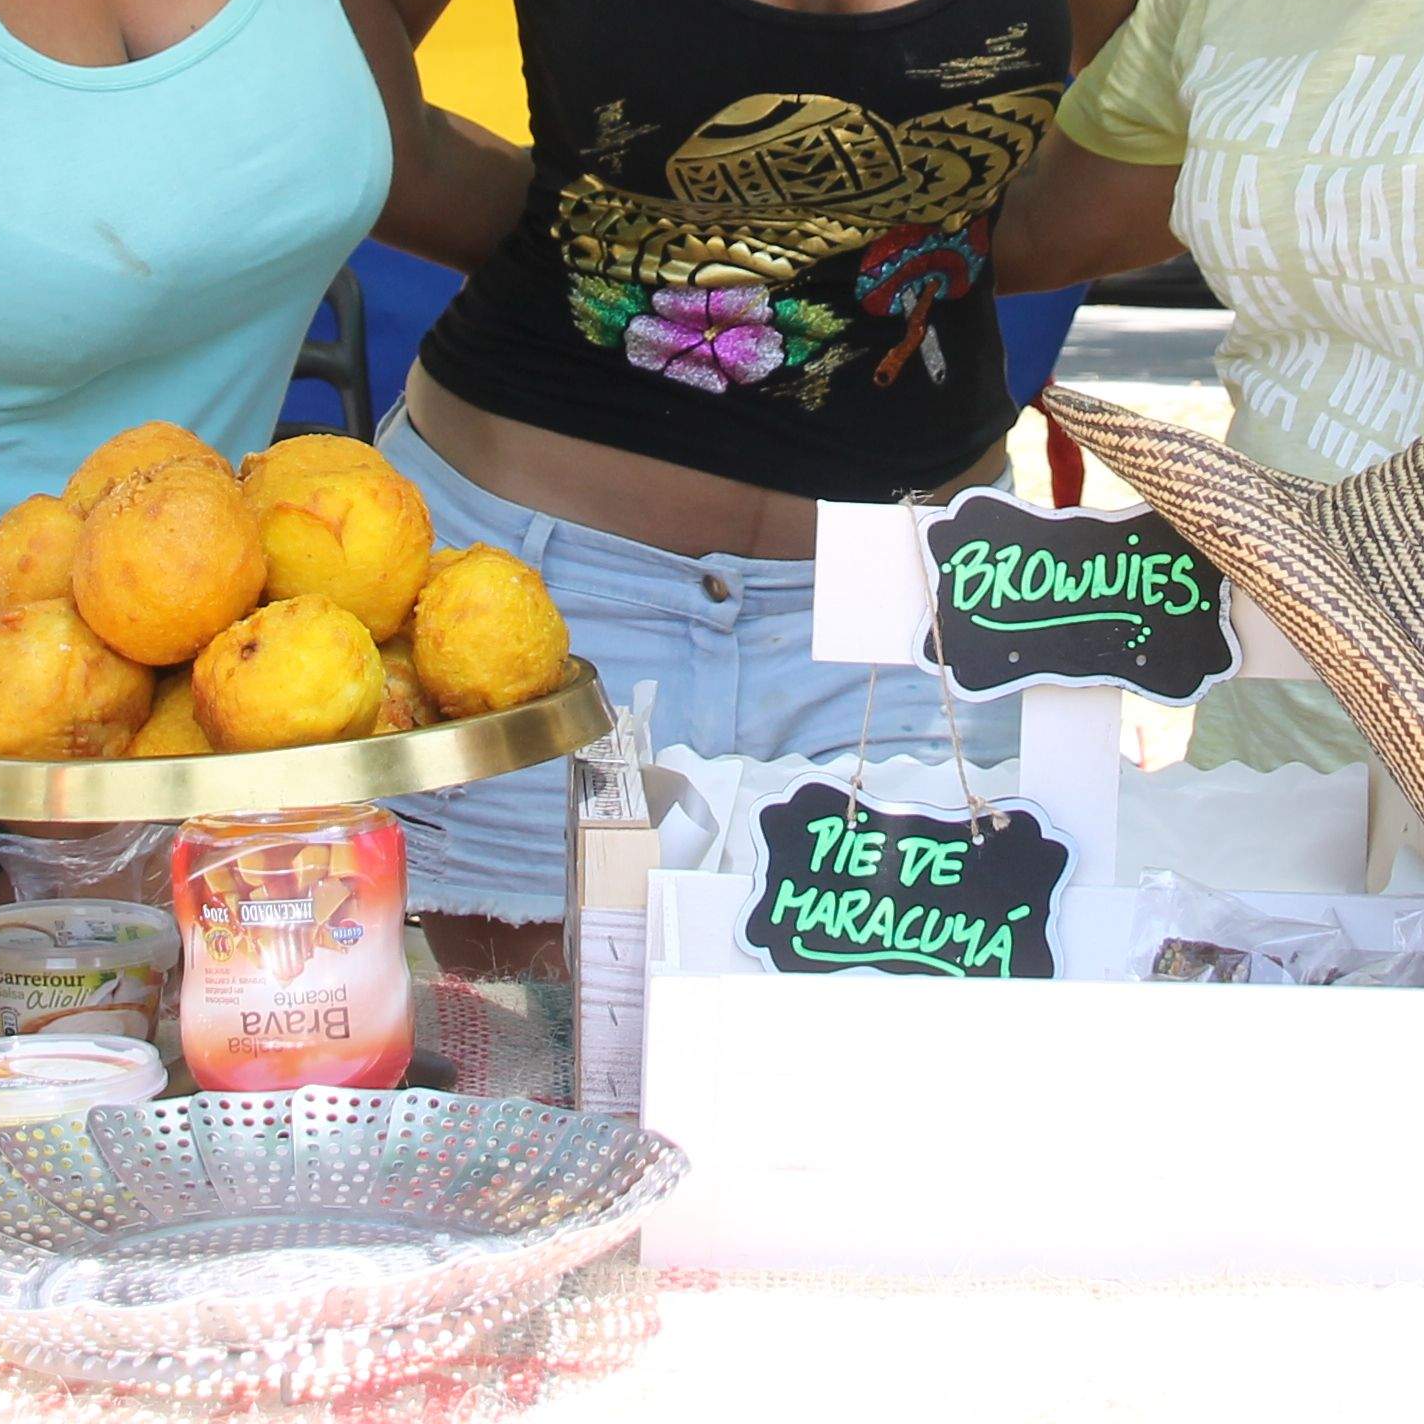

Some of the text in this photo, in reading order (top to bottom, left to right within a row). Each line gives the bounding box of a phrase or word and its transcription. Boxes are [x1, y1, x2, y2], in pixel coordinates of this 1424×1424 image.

[807, 811, 969, 887] PIE DE
[240, 901, 313, 922] HACENDADO
[769, 878, 1031, 978] MARACUYÁ
[26, 987, 92, 1010] alioli
[273, 983, 348, 1007] picante
[240, 1006, 351, 1040] Brava
